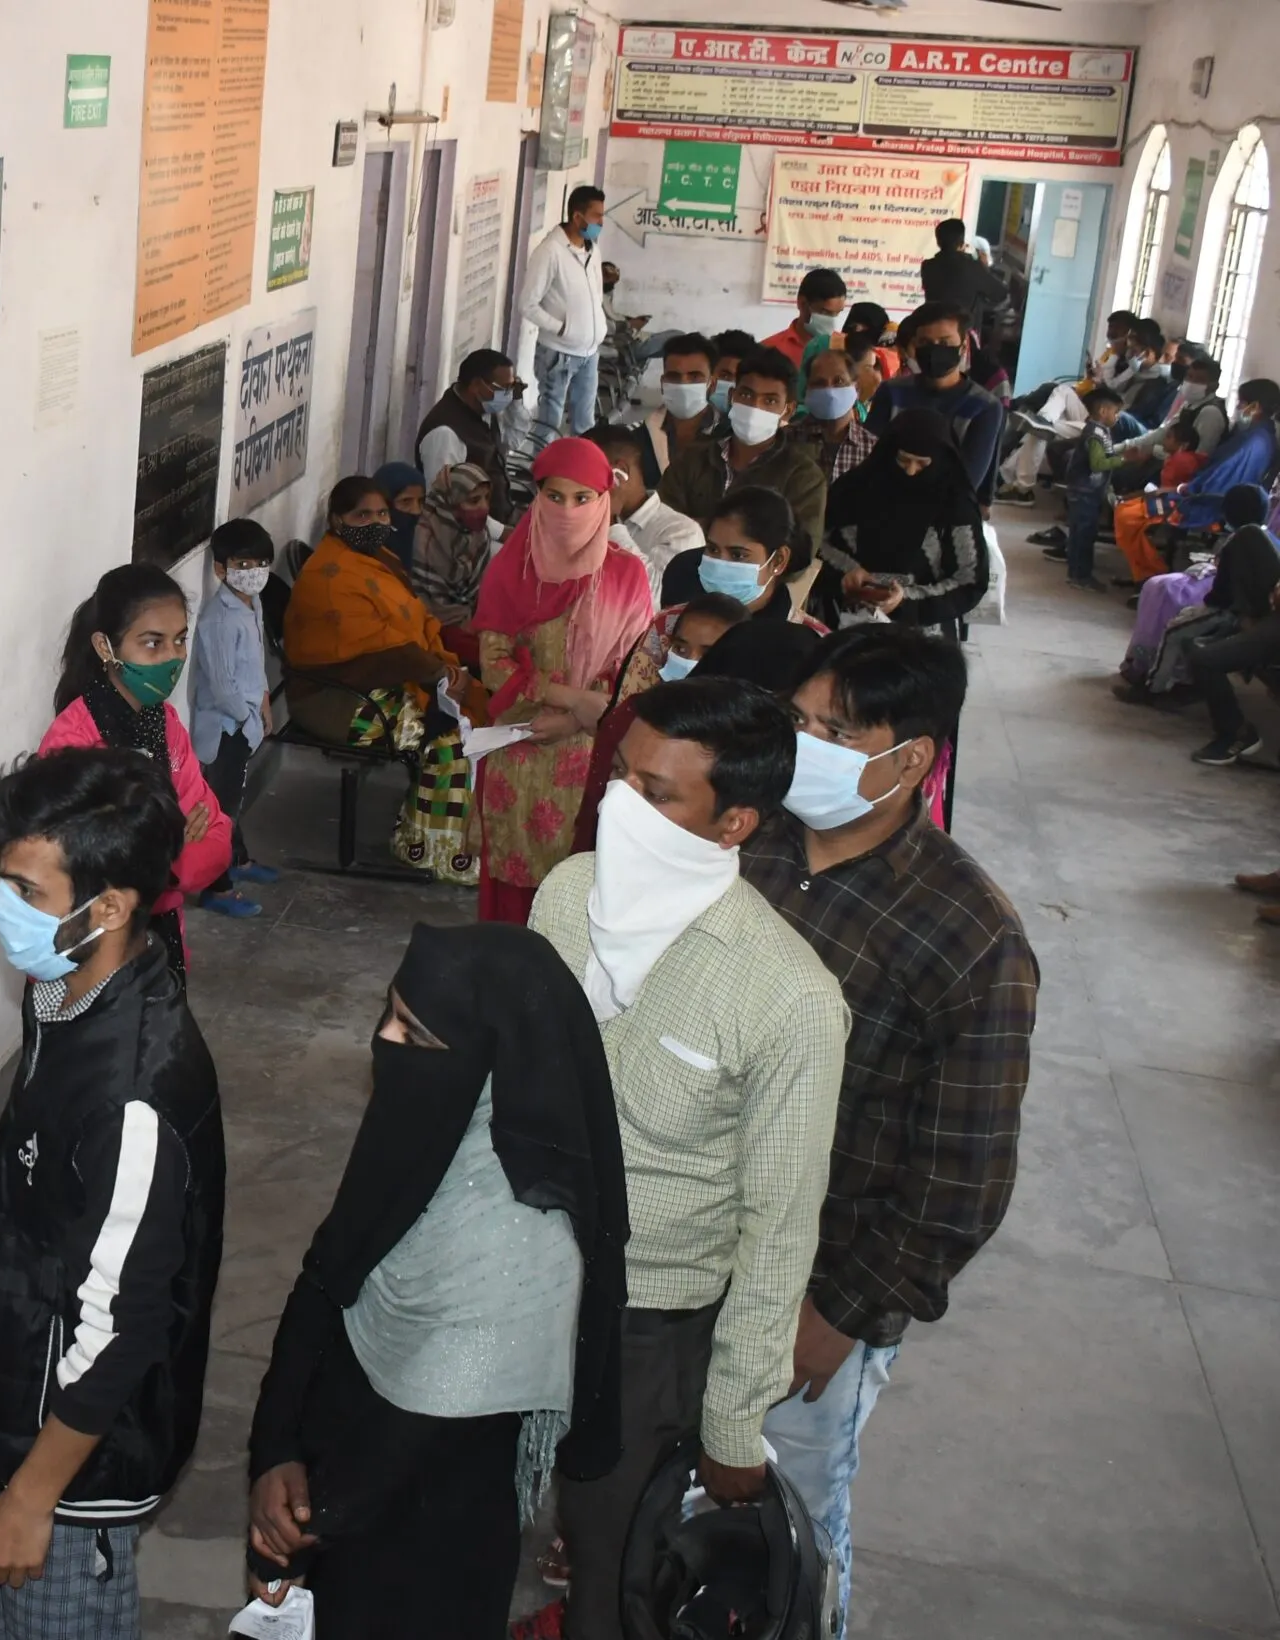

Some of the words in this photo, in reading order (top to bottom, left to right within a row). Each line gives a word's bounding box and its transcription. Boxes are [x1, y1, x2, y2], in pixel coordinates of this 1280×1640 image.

[900, 50, 971, 72] A.R.T.
[979, 53, 1065, 76] Centre
[71, 104, 86, 123] FIRE
[87, 102, 102, 121] EXIT
[916, 142, 945, 155] Pratap
[947, 144, 979, 155] District
[981, 146, 1025, 158] Combined
[1027, 148, 1066, 160] Hospital,
[817, 163, 847, 177] उत्तर
[852, 163, 884, 179] प्रदेश
[890, 167, 920, 180] राज्य
[680, 175, 693, 186] C.
[704, 176, 712, 188] T.
[722, 178, 735, 190] C.
[790, 181, 820, 198] एड्स
[885, 182, 944, 200] सोसाइटी
[845, 248, 859, 260] End
[887, 252, 901, 263] End
[275, 342, 288, 394] पर
[287, 331, 313, 399] थूकना
[234, 441, 245, 492] व
[275, 409, 297, 462] मना
